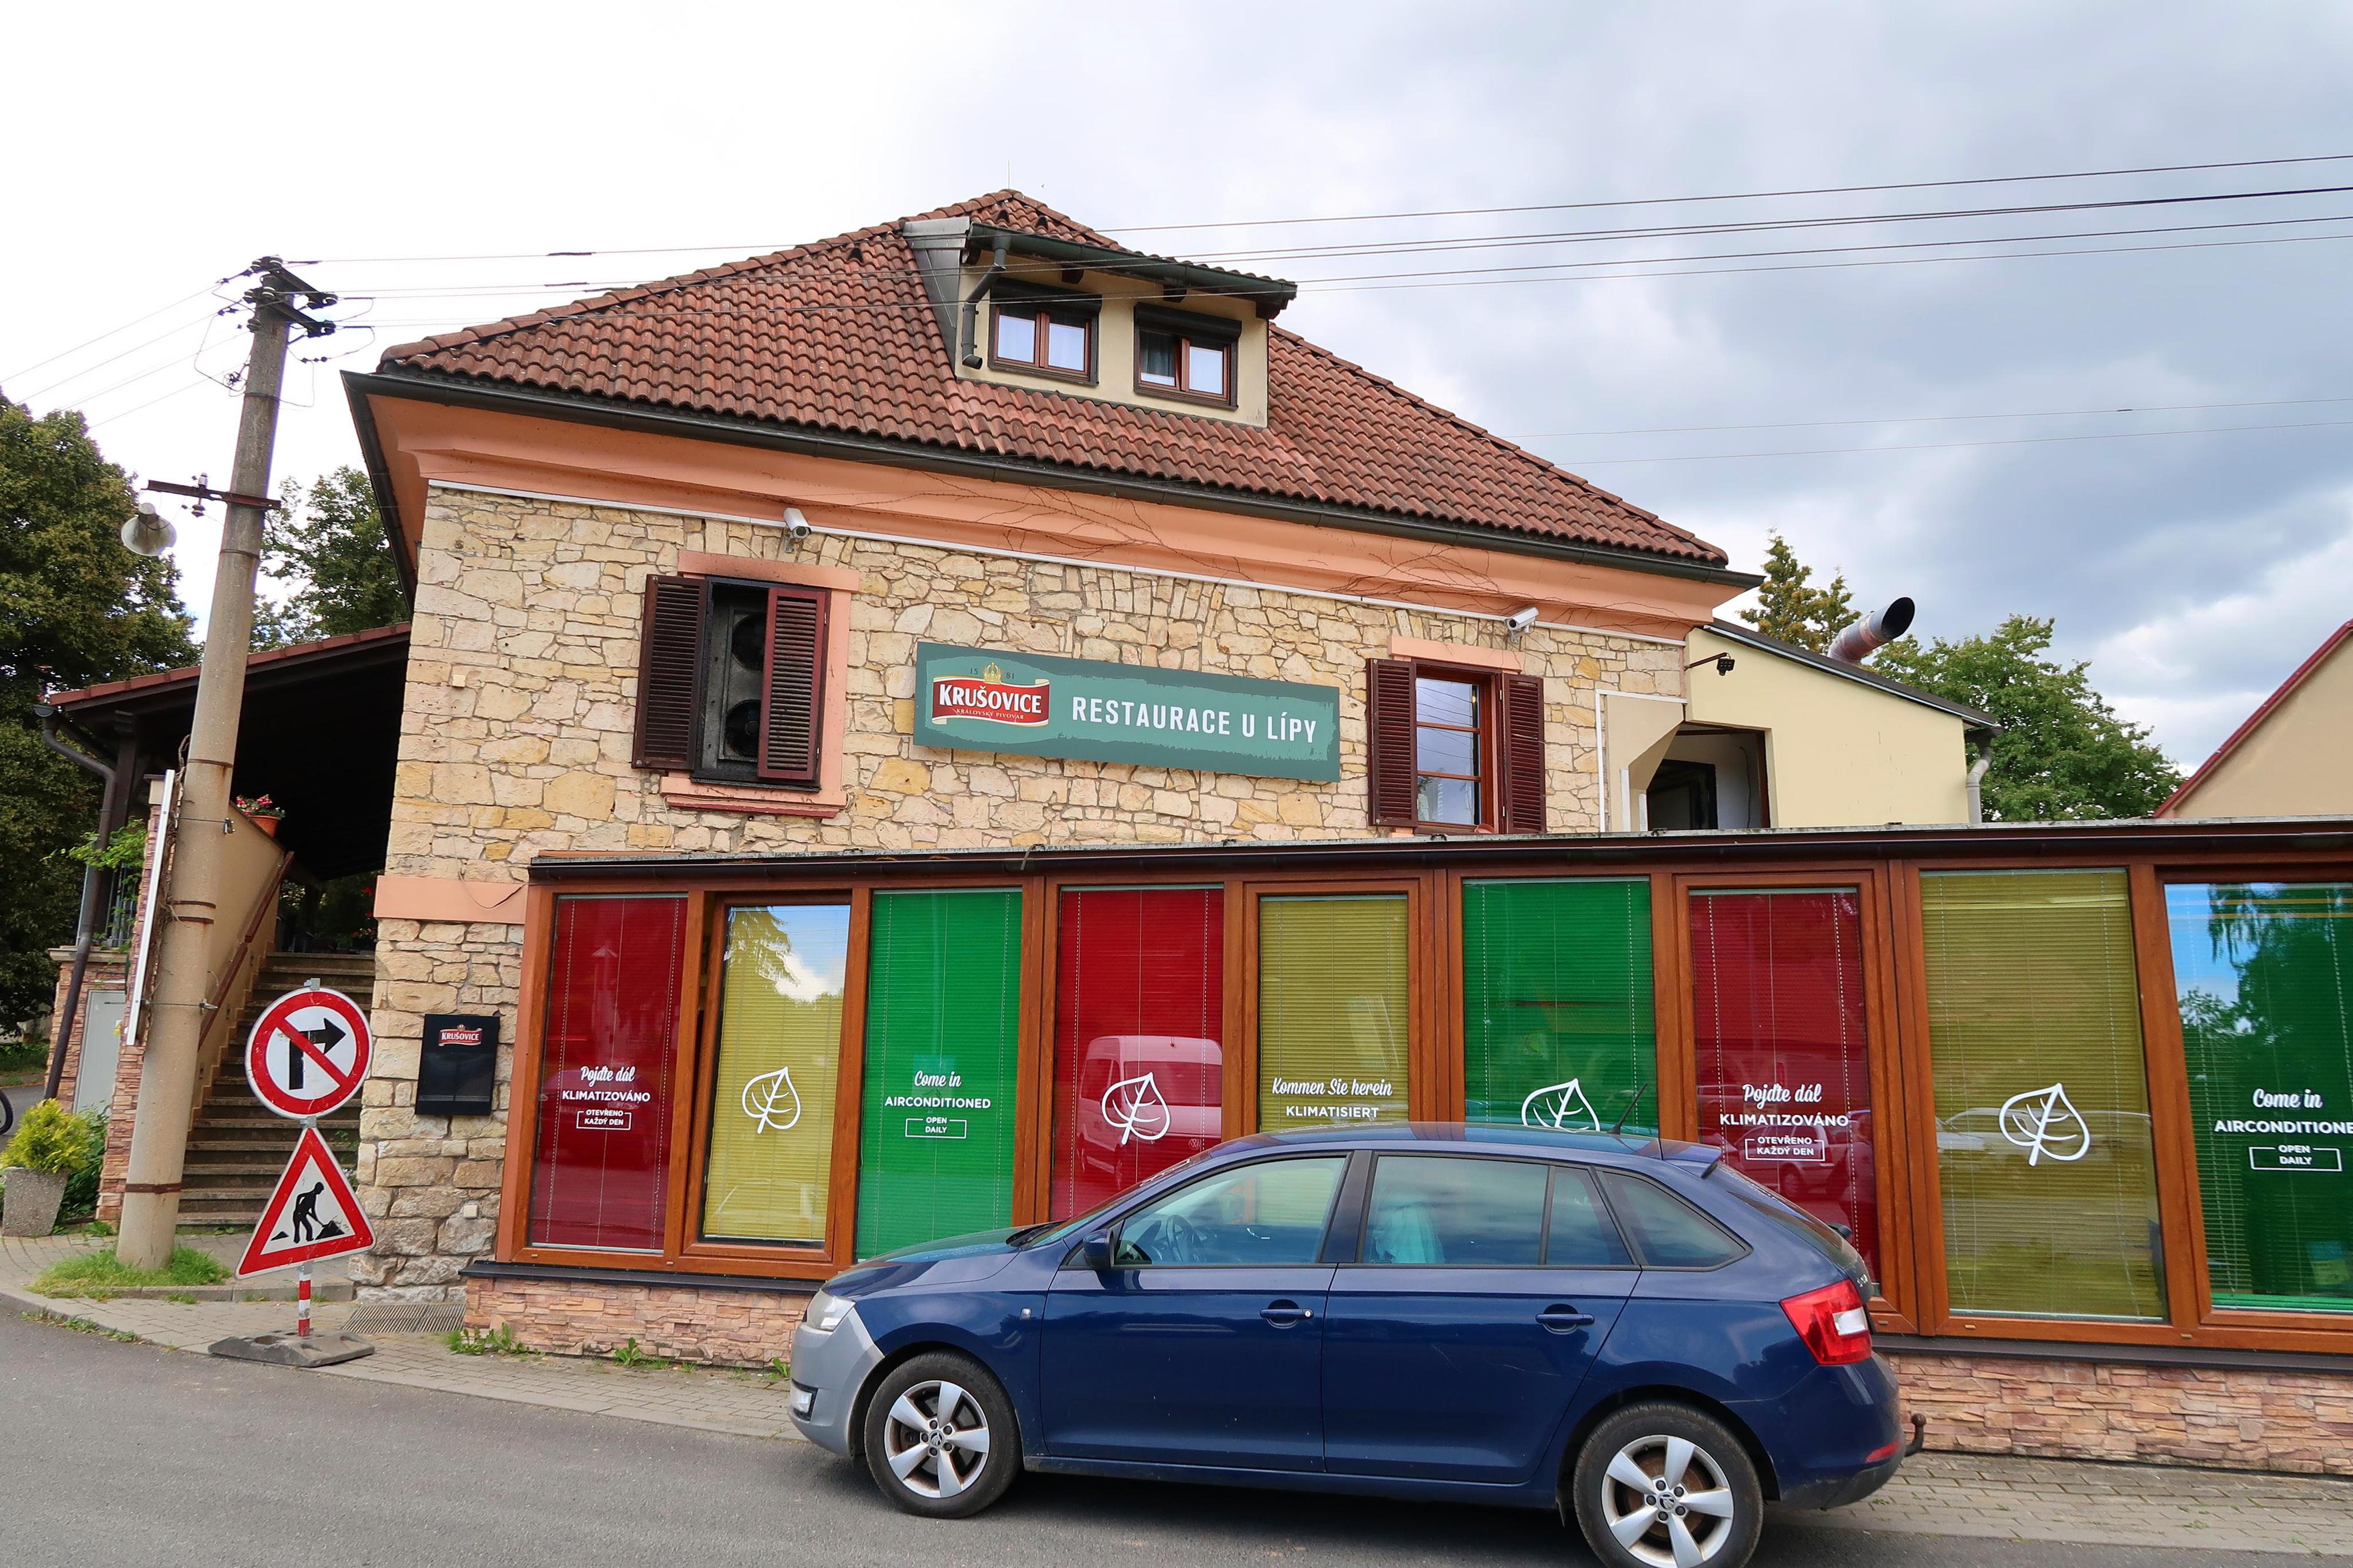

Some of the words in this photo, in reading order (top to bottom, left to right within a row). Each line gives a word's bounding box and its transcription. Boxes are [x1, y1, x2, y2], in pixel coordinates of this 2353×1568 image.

[939, 684, 1042, 713] KRUŠOVICE
[956, 708, 994, 717] KRÁLOVSKÝ
[1072, 696, 1230, 735] RESTAURACE
[1242, 713, 1255, 738] U
[1267, 712, 1317, 743] LÍPY
[441, 1032, 480, 1040] KRUŠOVICE
[615, 1066, 636, 1082] dál
[914, 1070, 946, 1087] Come
[948, 1071, 962, 1087] in
[1272, 1077, 1326, 1095] Kommen
[1327, 1078, 1349, 1095] Sie
[1351, 1079, 1393, 1096] herein
[1794, 1083, 1822, 1103] dál
[562, 1090, 651, 1103] KLIMATIZOVÁNO
[884, 1096, 991, 1109] AIRCONDITIONED
[2252, 1088, 2301, 1108] Come
[2303, 1089, 2324, 1109] in
[586, 1108, 624, 1116] OTEVŘENO
[1286, 1106, 1379, 1117] KLIMATISIERT
[1720, 1112, 1849, 1127] KLIMATIZOVÁNO
[1757, 1136, 1812, 1145] OTEVŘENO
[1757, 1145, 1789, 1155] KAŽDÝ
[1794, 1147, 1814, 1156] DEN
[2278, 1145, 2311, 1153] OPEN
[2279, 1156, 2312, 1165] DAILY
